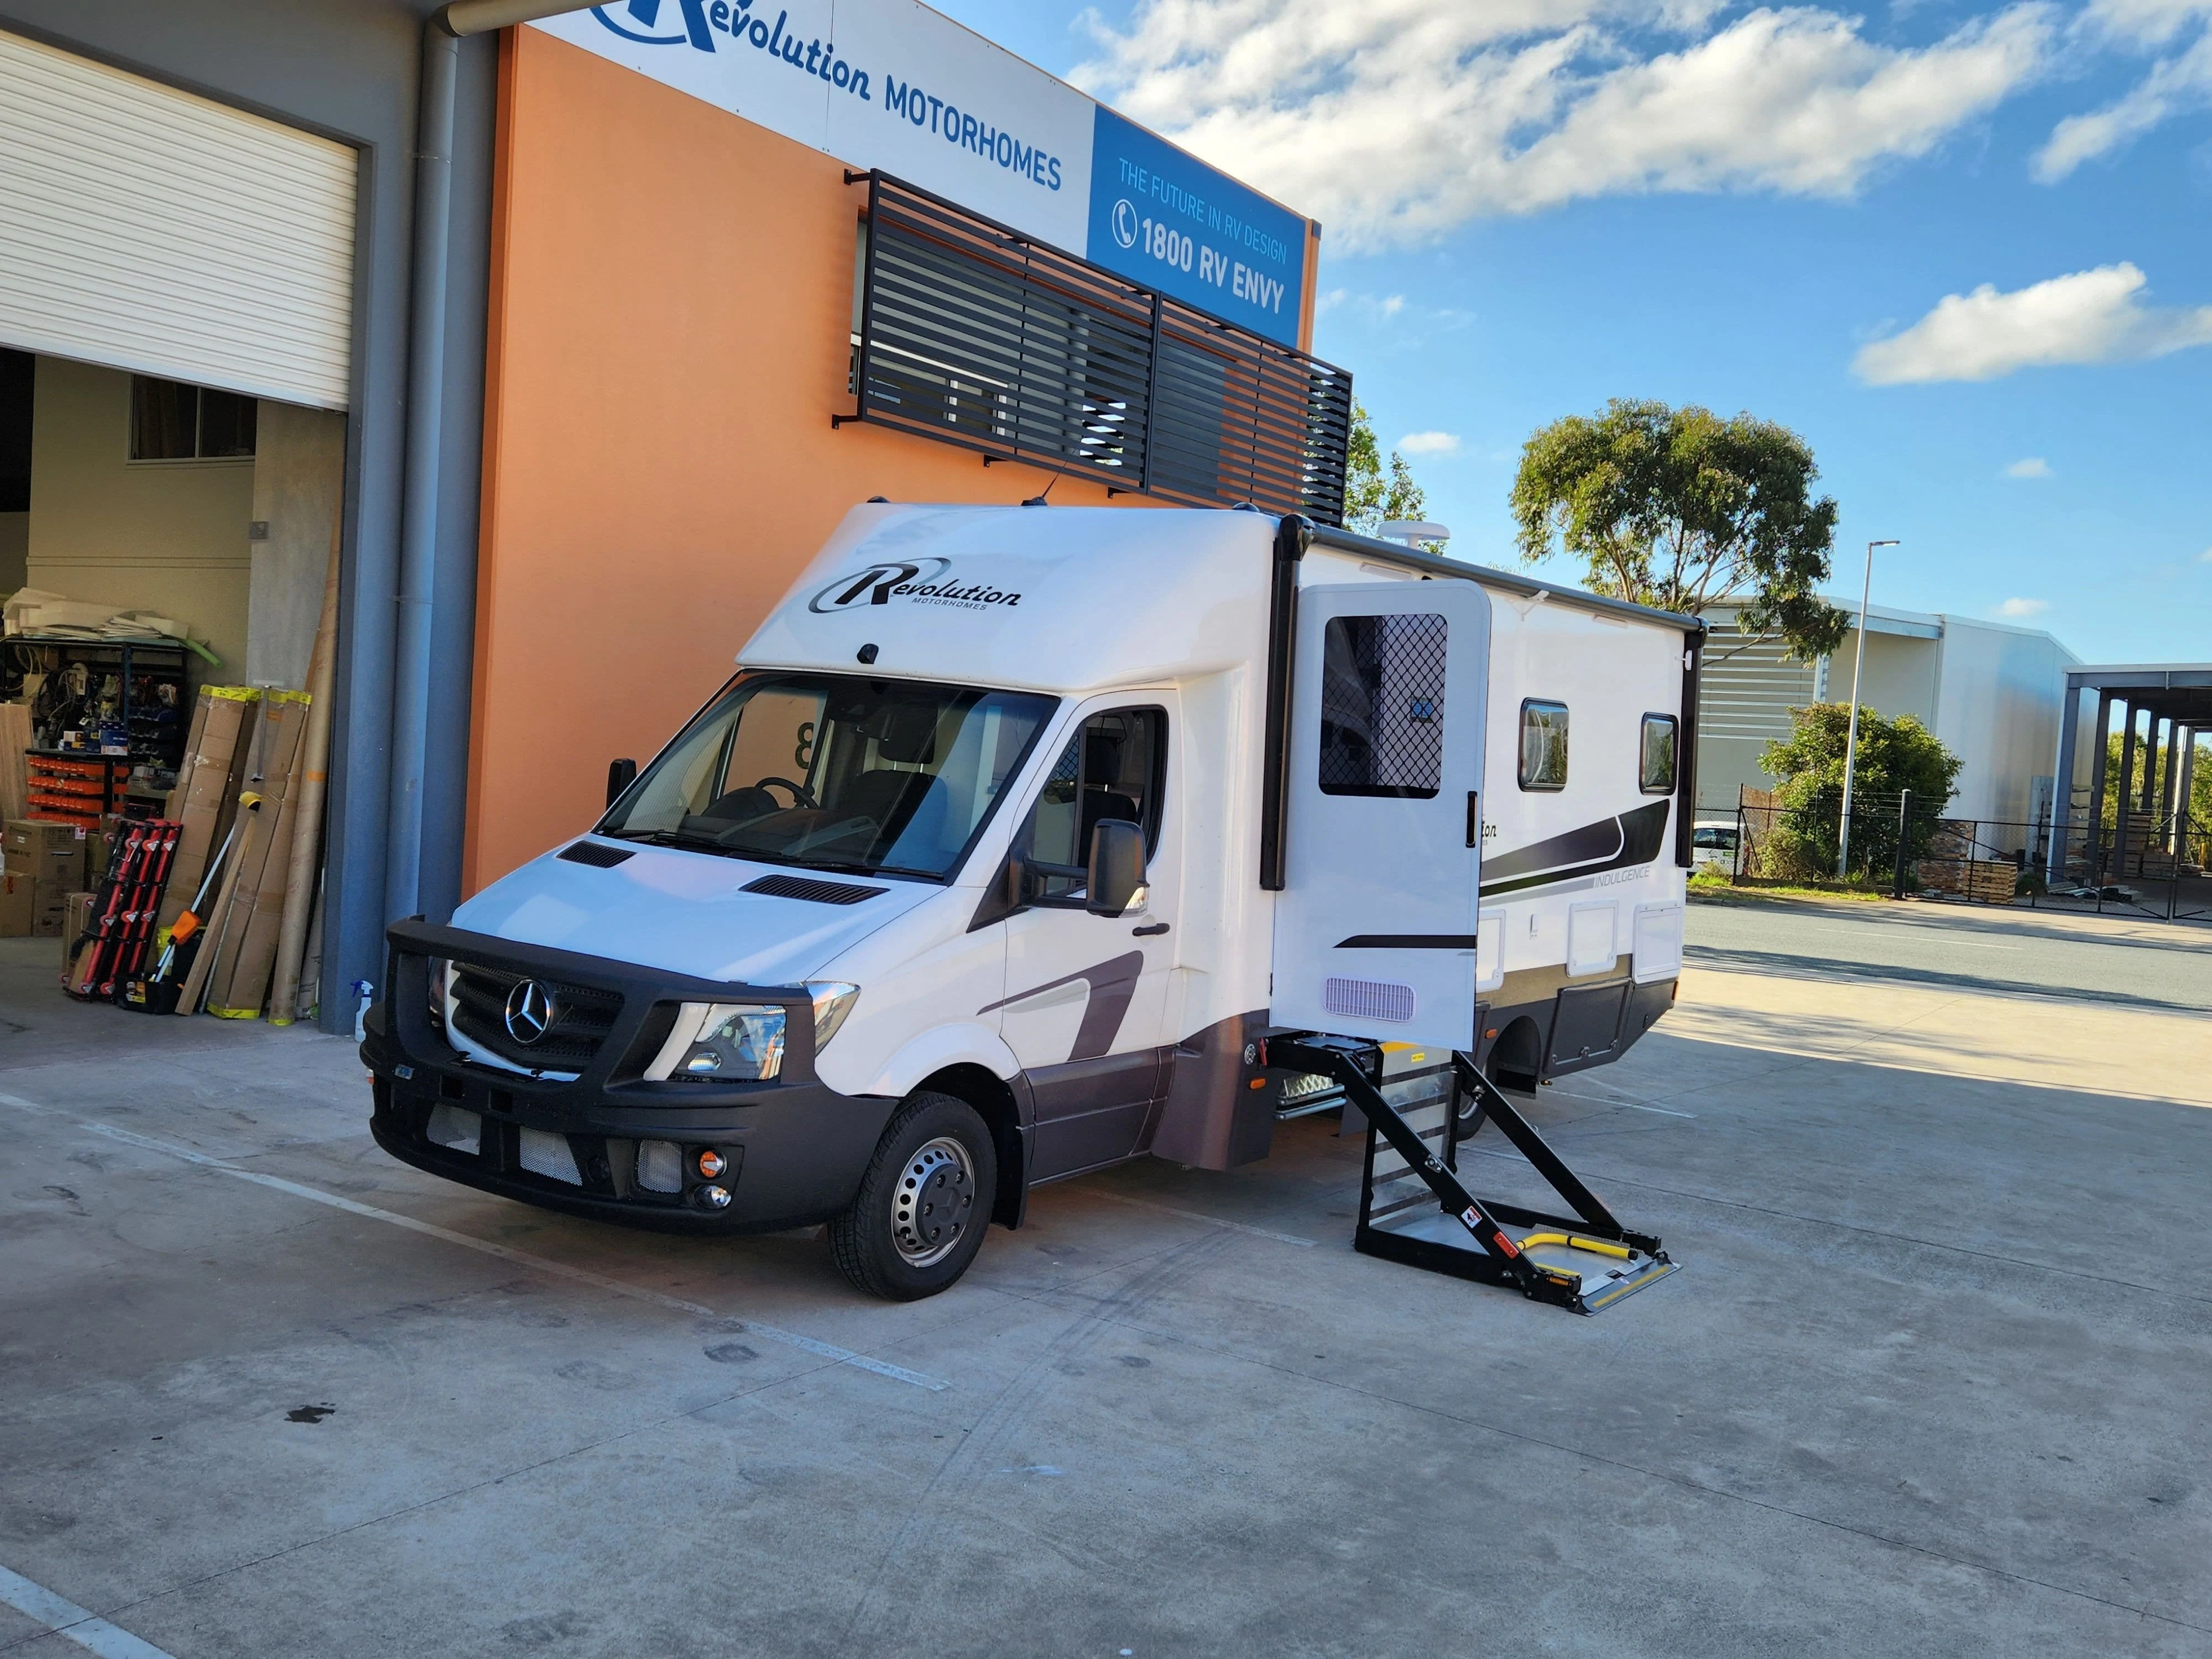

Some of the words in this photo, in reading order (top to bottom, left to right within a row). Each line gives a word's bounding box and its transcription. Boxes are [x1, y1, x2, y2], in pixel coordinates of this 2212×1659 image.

[885, 74, 1061, 191] MOTORHOMES
[1119, 157, 1147, 194] THE
[1151, 175, 1205, 223] FUTURE
[1208, 205, 1221, 232] IN
[1224, 214, 1241, 241] RV
[1244, 224, 1287, 265] DESIGN
[1142, 217, 1193, 273] 1800
[1199, 244, 1228, 288] RV
[1233, 261, 1285, 314] ENVY
[833, 563, 1022, 607] Revolution
[911, 597, 988, 611] MOTORHOMES
[1594, 865, 1651, 888] INDULGENCE
